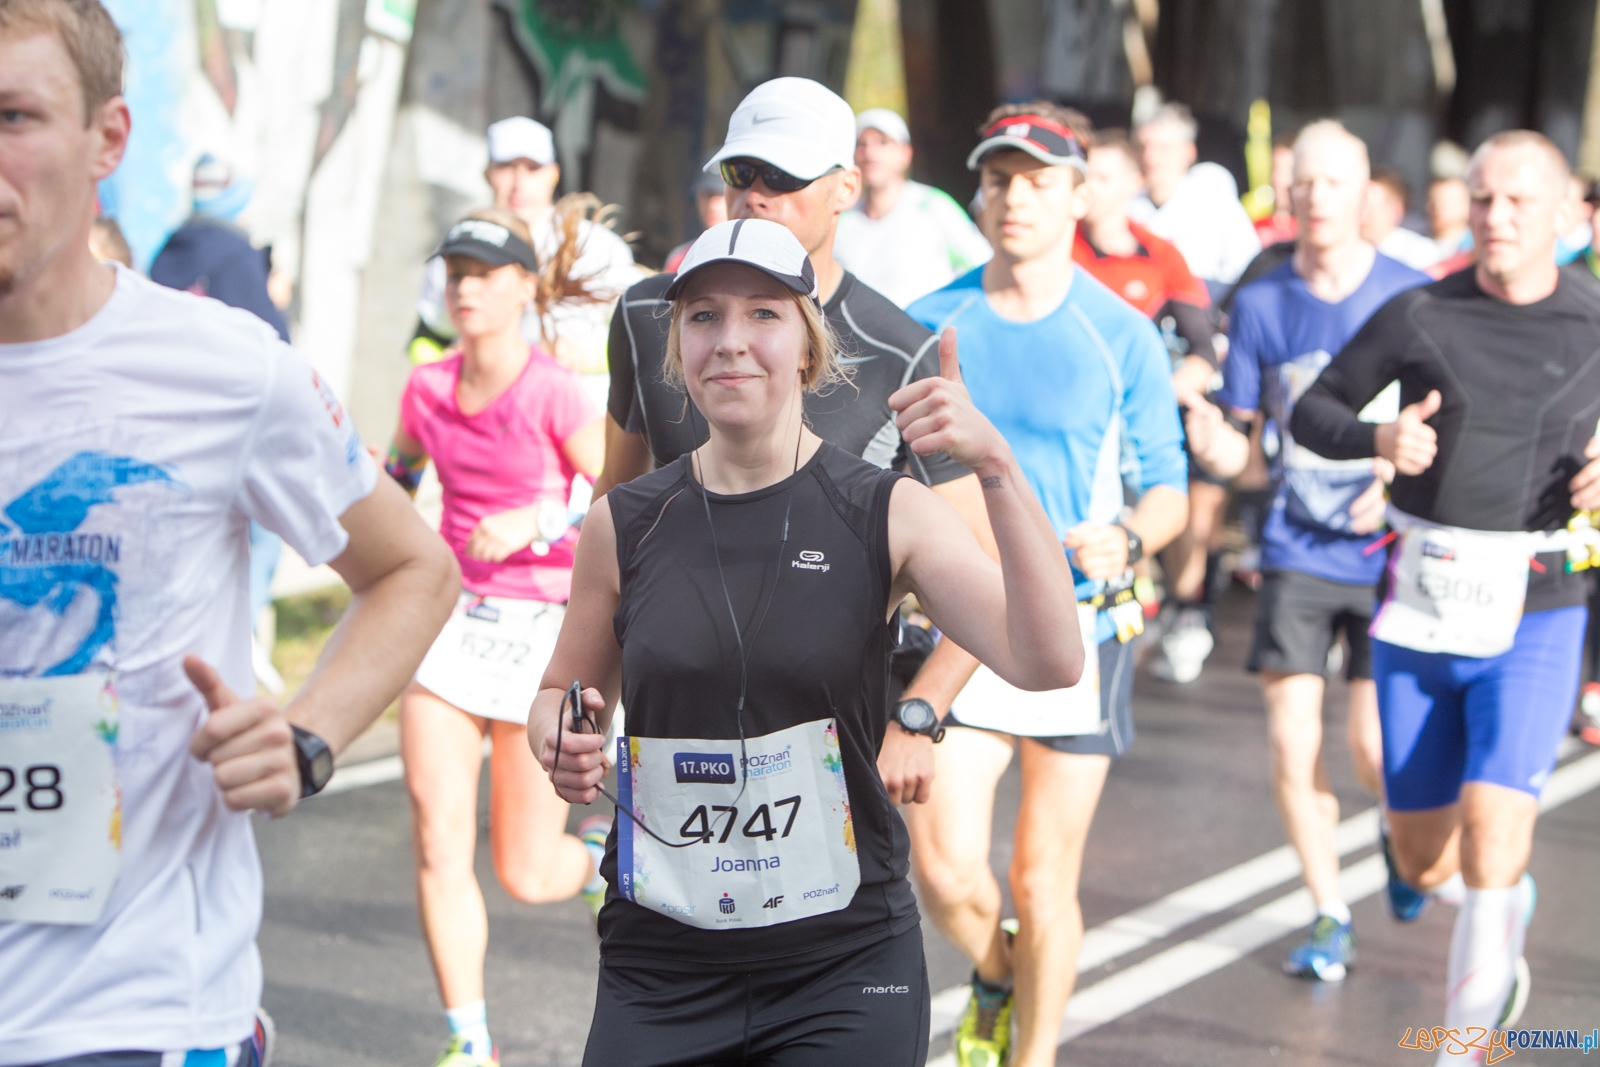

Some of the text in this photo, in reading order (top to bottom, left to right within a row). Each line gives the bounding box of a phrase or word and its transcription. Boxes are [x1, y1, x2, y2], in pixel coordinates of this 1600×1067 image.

[12, 533, 121, 565] MARATON
[791, 560, 830, 573] Kalenji
[460, 631, 532, 667] 6272
[621, 744, 629, 773] 9.10.201
[680, 761, 730, 775] 17.PKO
[741, 760, 792, 778] maraton
[679, 795, 802, 844] 4747
[711, 856, 781, 872] Joanna
[862, 984, 909, 994] martes
